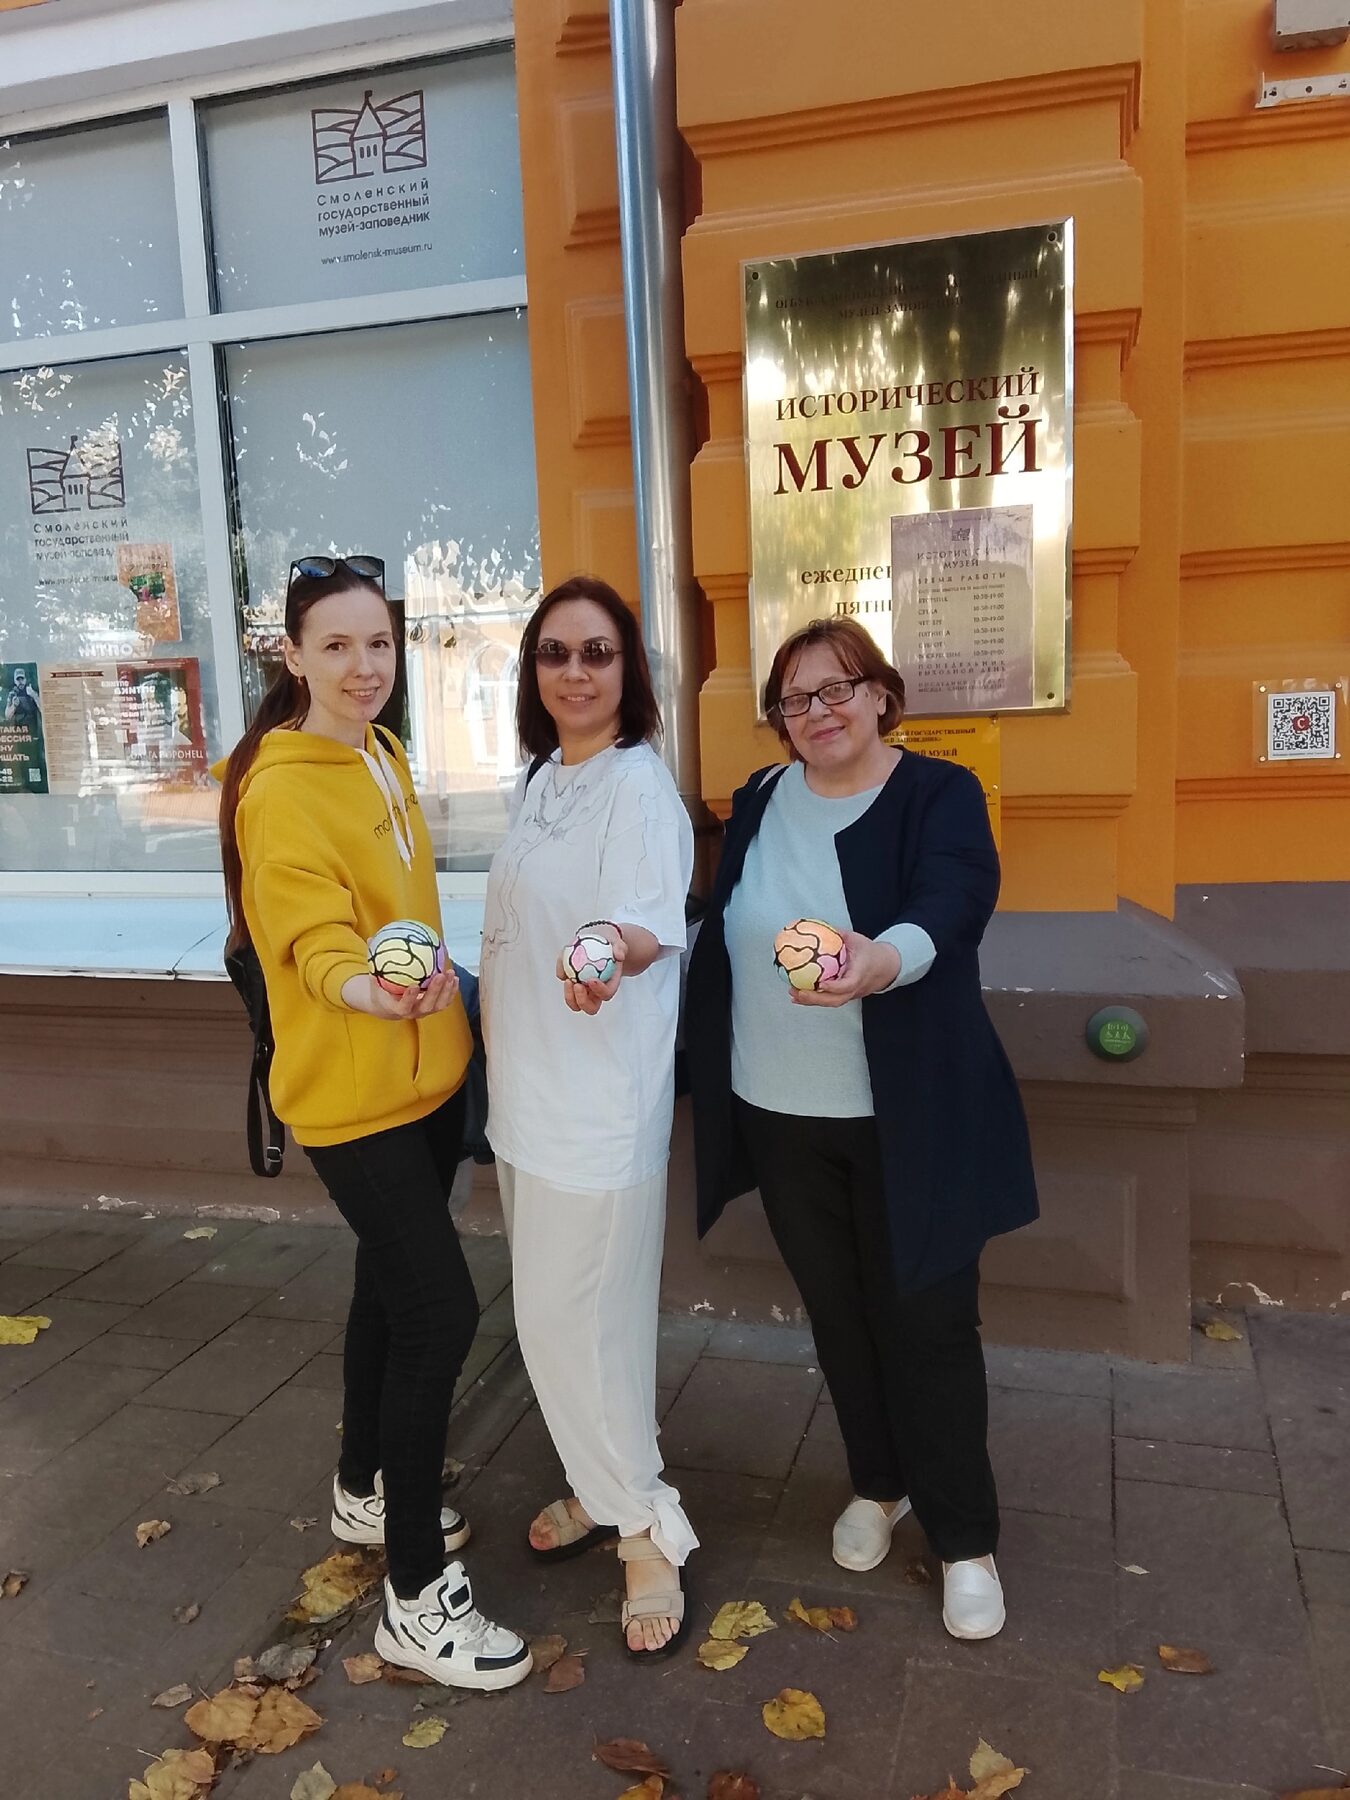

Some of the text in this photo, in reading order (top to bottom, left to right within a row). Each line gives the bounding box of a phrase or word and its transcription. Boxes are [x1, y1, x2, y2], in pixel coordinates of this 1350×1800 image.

[317, 178, 429, 206] Смоленский
[318, 193, 430, 222] государственный
[319, 211, 430, 238] музей-заповедник
[321, 242, 433, 265] www.smolensk-museum.ru
[775, 366, 1039, 421] ИСТОРИЧЕСКИЙ
[773, 403, 1043, 495] МУЗЕЙ
[33, 518, 128, 534] Смоленский
[801, 565, 892, 586] ежедне
[943, 559, 979, 570] МУЗЕЙ
[0, 734, 32, 743] ЕССИЯ
